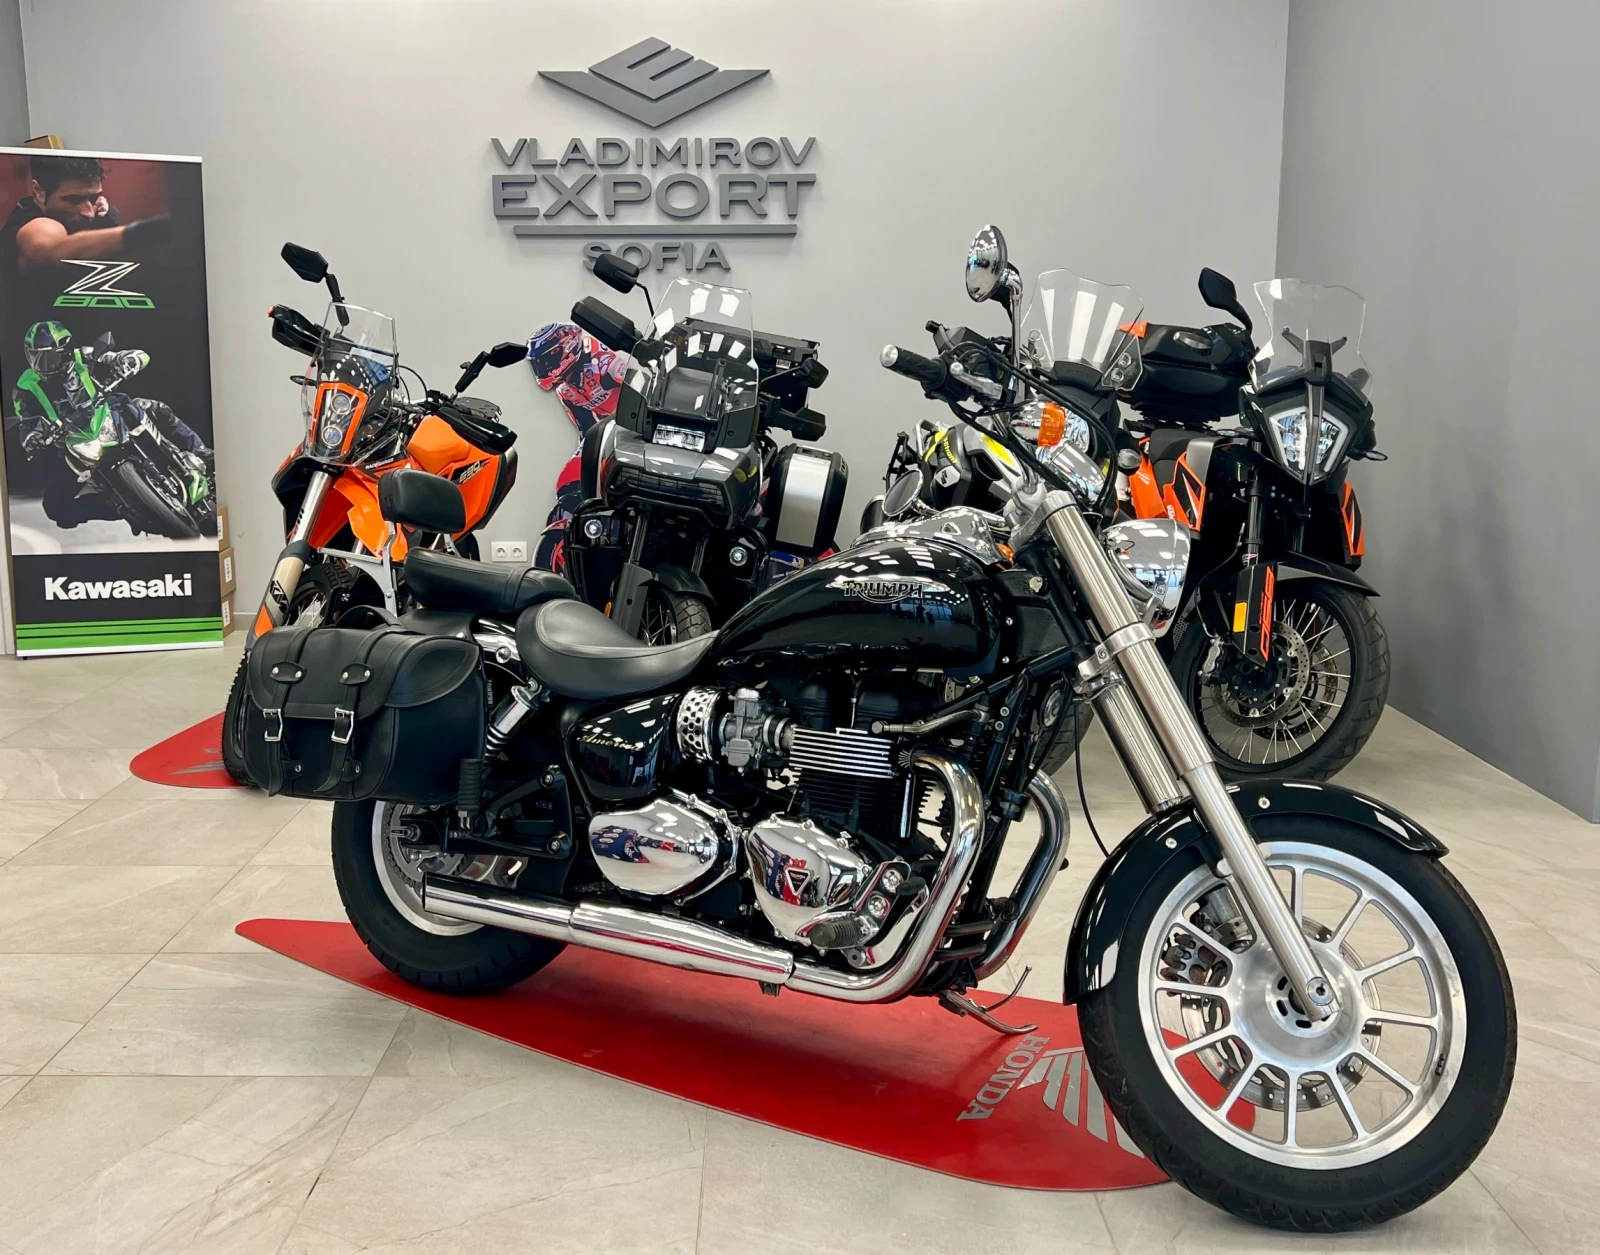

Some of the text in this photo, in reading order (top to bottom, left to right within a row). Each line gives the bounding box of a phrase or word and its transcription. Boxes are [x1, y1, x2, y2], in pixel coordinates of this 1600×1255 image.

[491, 137, 816, 166] VLADIMIROV
[492, 173, 816, 217] EXPORT
[582, 242, 731, 270] SOFIA
[53, 295, 156, 309] 800
[44, 573, 192, 600] Kawasaki
[843, 580, 923, 603] TRIUMPH
[956, 1033, 1051, 1121] HONDA
